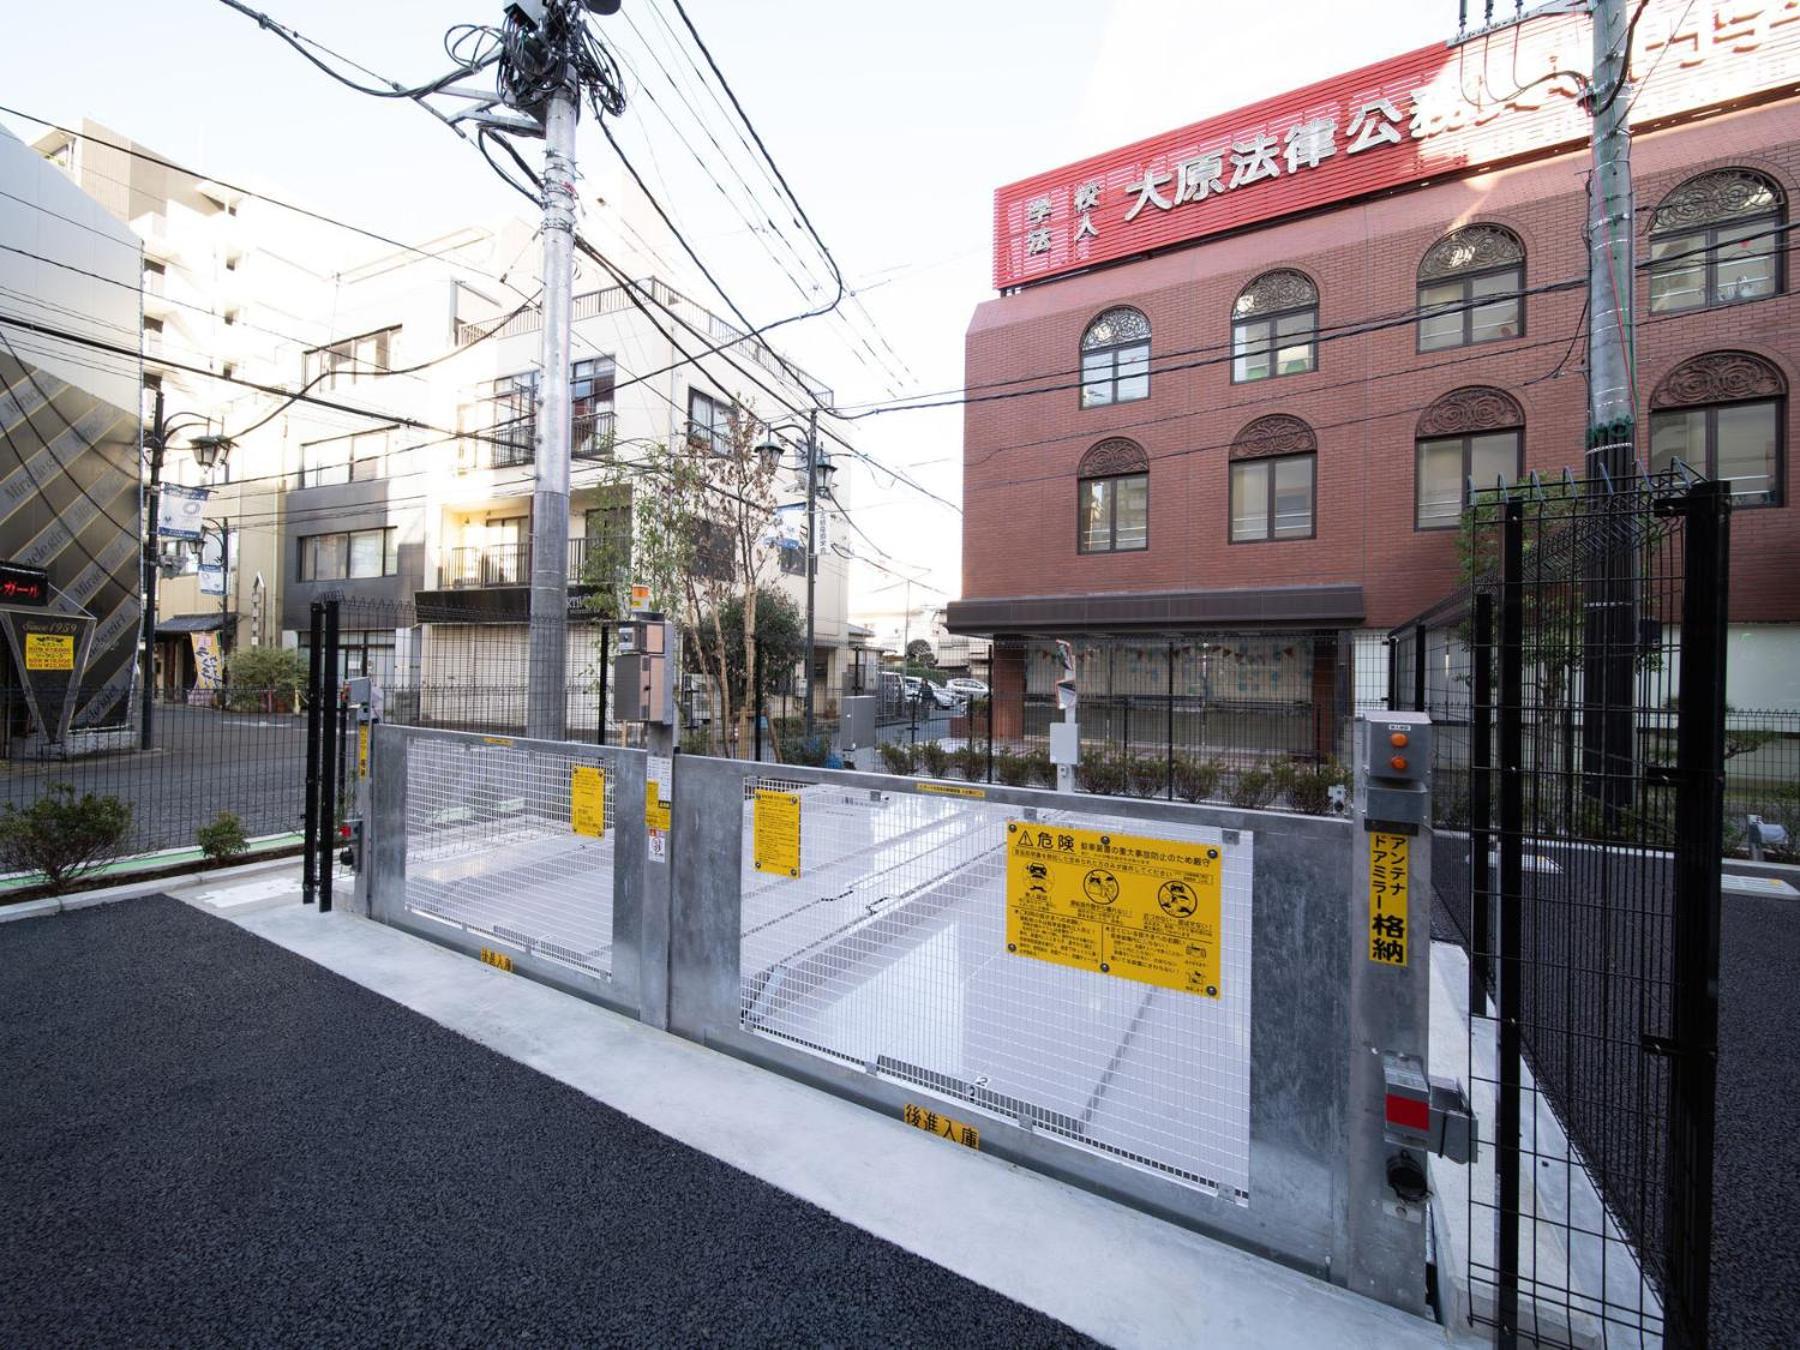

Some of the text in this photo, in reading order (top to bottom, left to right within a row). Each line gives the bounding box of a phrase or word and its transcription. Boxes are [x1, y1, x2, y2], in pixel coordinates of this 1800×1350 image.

[1037, 832, 1075, 853] 危険
[1390, 836, 1407, 896] アンテナ
[1372, 835, 1388, 911] ドアミラー
[1372, 914, 1406, 964] 格納
[905, 1103, 978, 1150] 後進入庫
